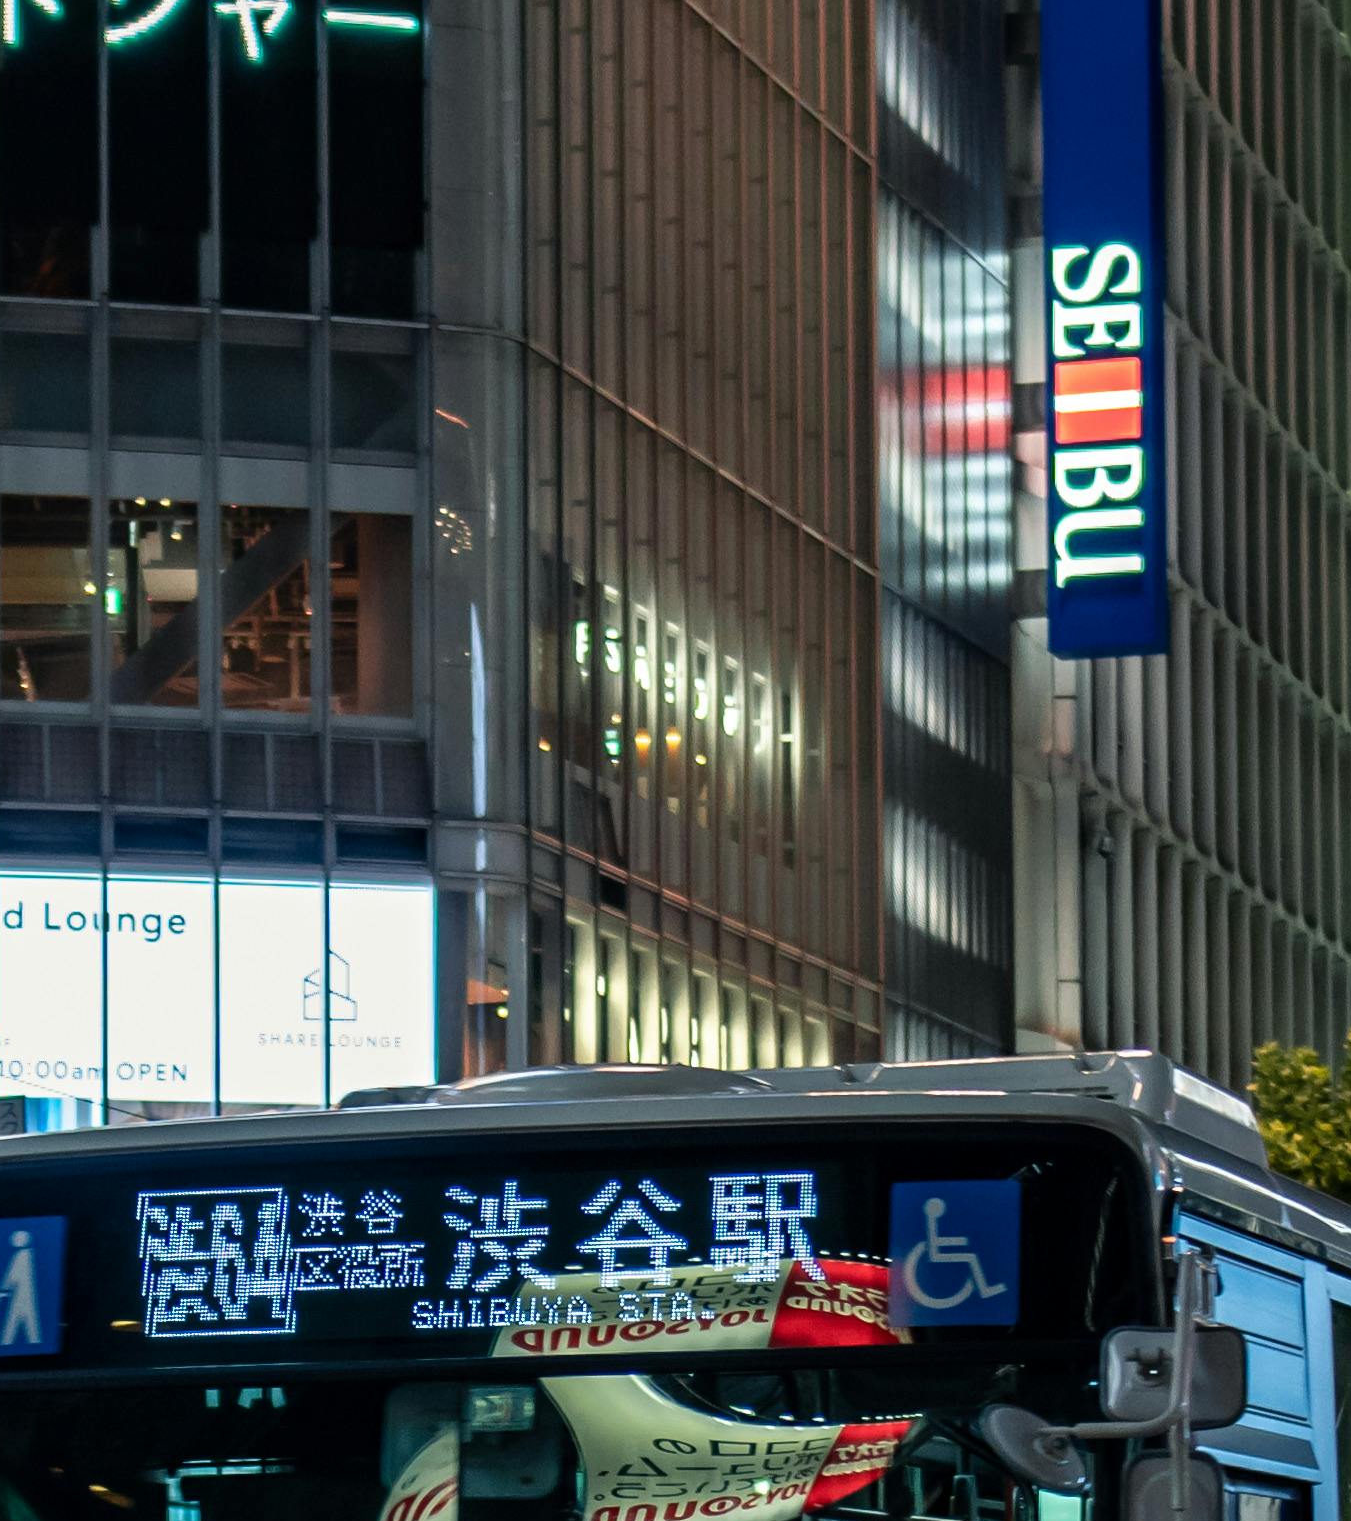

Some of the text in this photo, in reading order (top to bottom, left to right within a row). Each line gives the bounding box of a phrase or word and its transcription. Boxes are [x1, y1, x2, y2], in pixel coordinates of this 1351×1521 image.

[1050, 239, 1146, 590] SEIBU
[43, 899, 188, 943] Lounge
[257, 1031, 320, 1049] SHARE
[115, 1060, 189, 1082] OPEN
[297, 1187, 405, 1239] 渋谷
[442, 1169, 828, 1295] 渋谷駅
[293, 1240, 428, 1292] 区役所
[411, 1289, 716, 1332] SHIBUYA STA.
